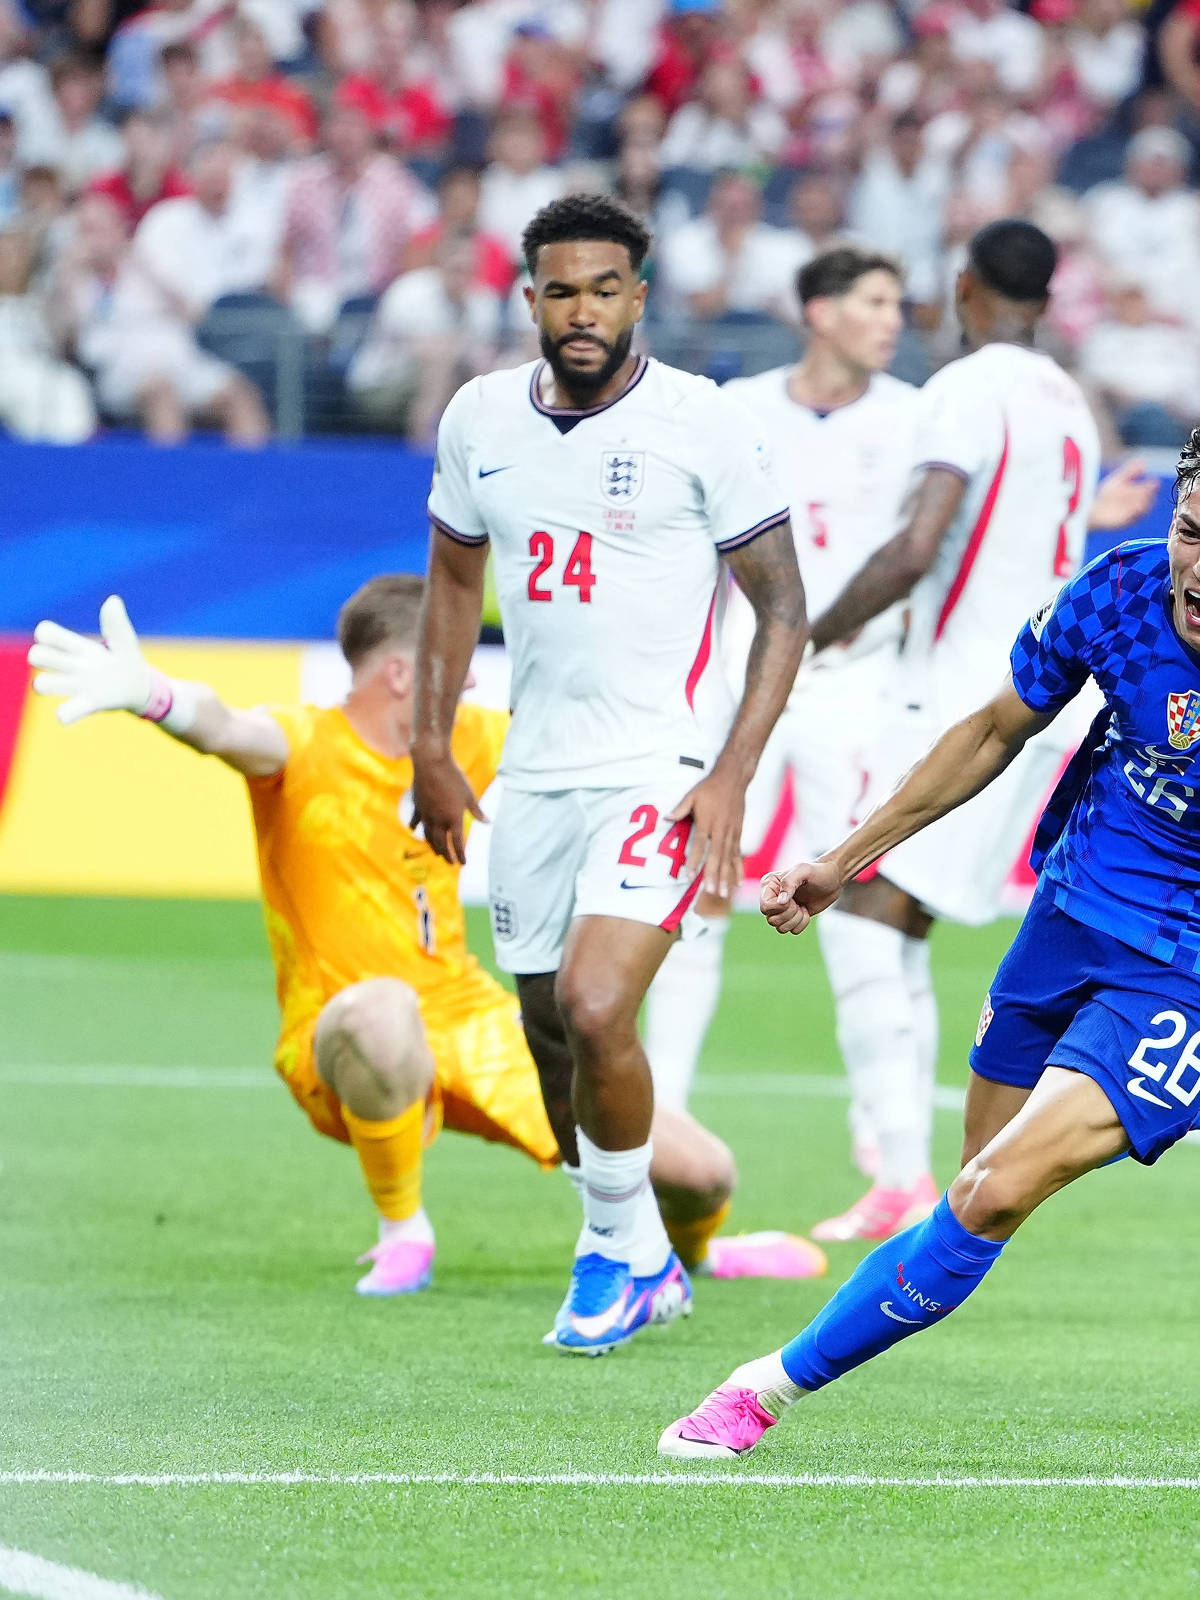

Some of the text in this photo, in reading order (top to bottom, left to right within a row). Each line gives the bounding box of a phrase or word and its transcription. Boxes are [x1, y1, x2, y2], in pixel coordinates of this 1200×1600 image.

[528, 531, 596, 603] 24
[1124, 748, 1195, 822] 26
[618, 804, 692, 878] 24
[902, 1281, 941, 1312] HNS
